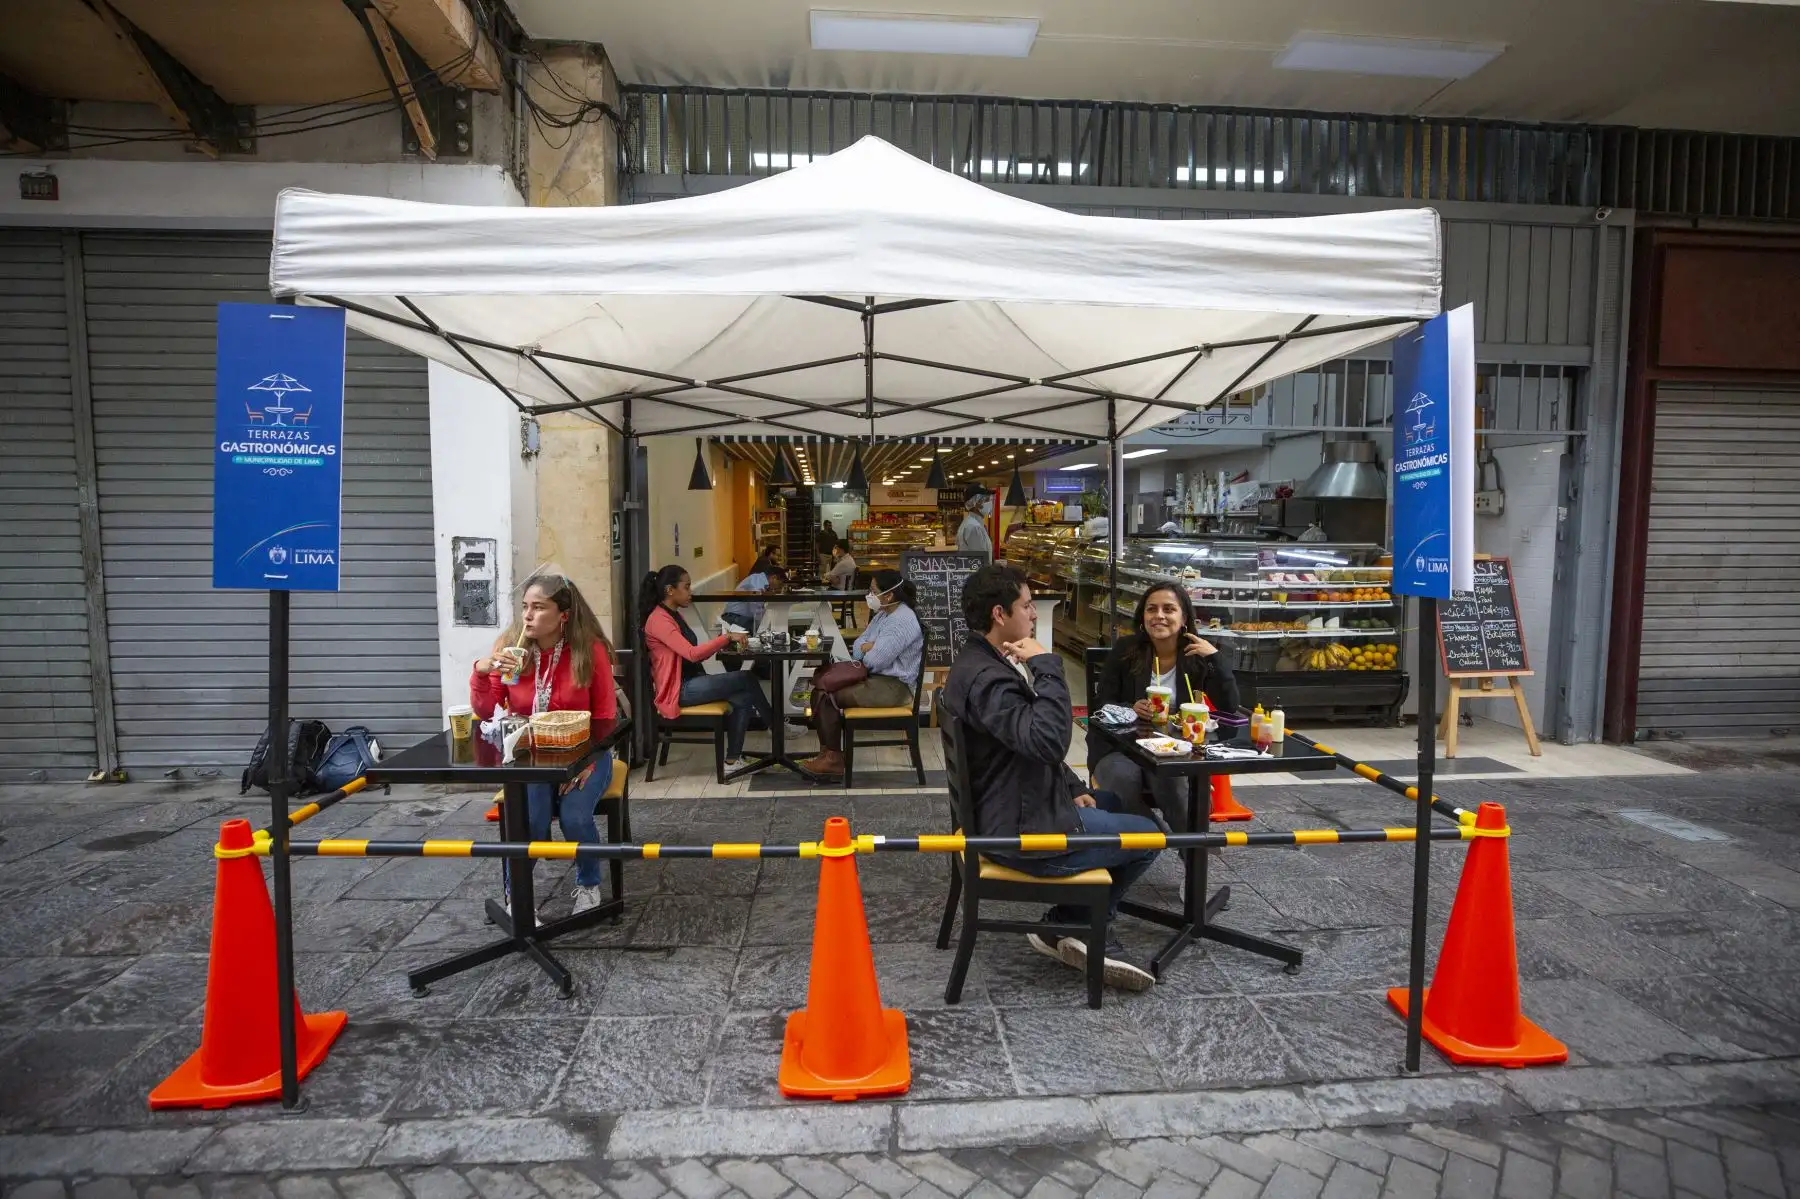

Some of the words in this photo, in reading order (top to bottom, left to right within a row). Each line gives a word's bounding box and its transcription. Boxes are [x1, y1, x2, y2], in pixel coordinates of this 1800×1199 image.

[248, 429, 310, 441] TERRAZAS
[221, 440, 336, 455] GASTRONÓMICAS
[1405, 443, 1435, 457] TERRAZAS
[1395, 452, 1448, 473] GASTRONÓMICAS
[295, 554, 335, 564] LIMA
[1428, 562, 1449, 573] LIMA
